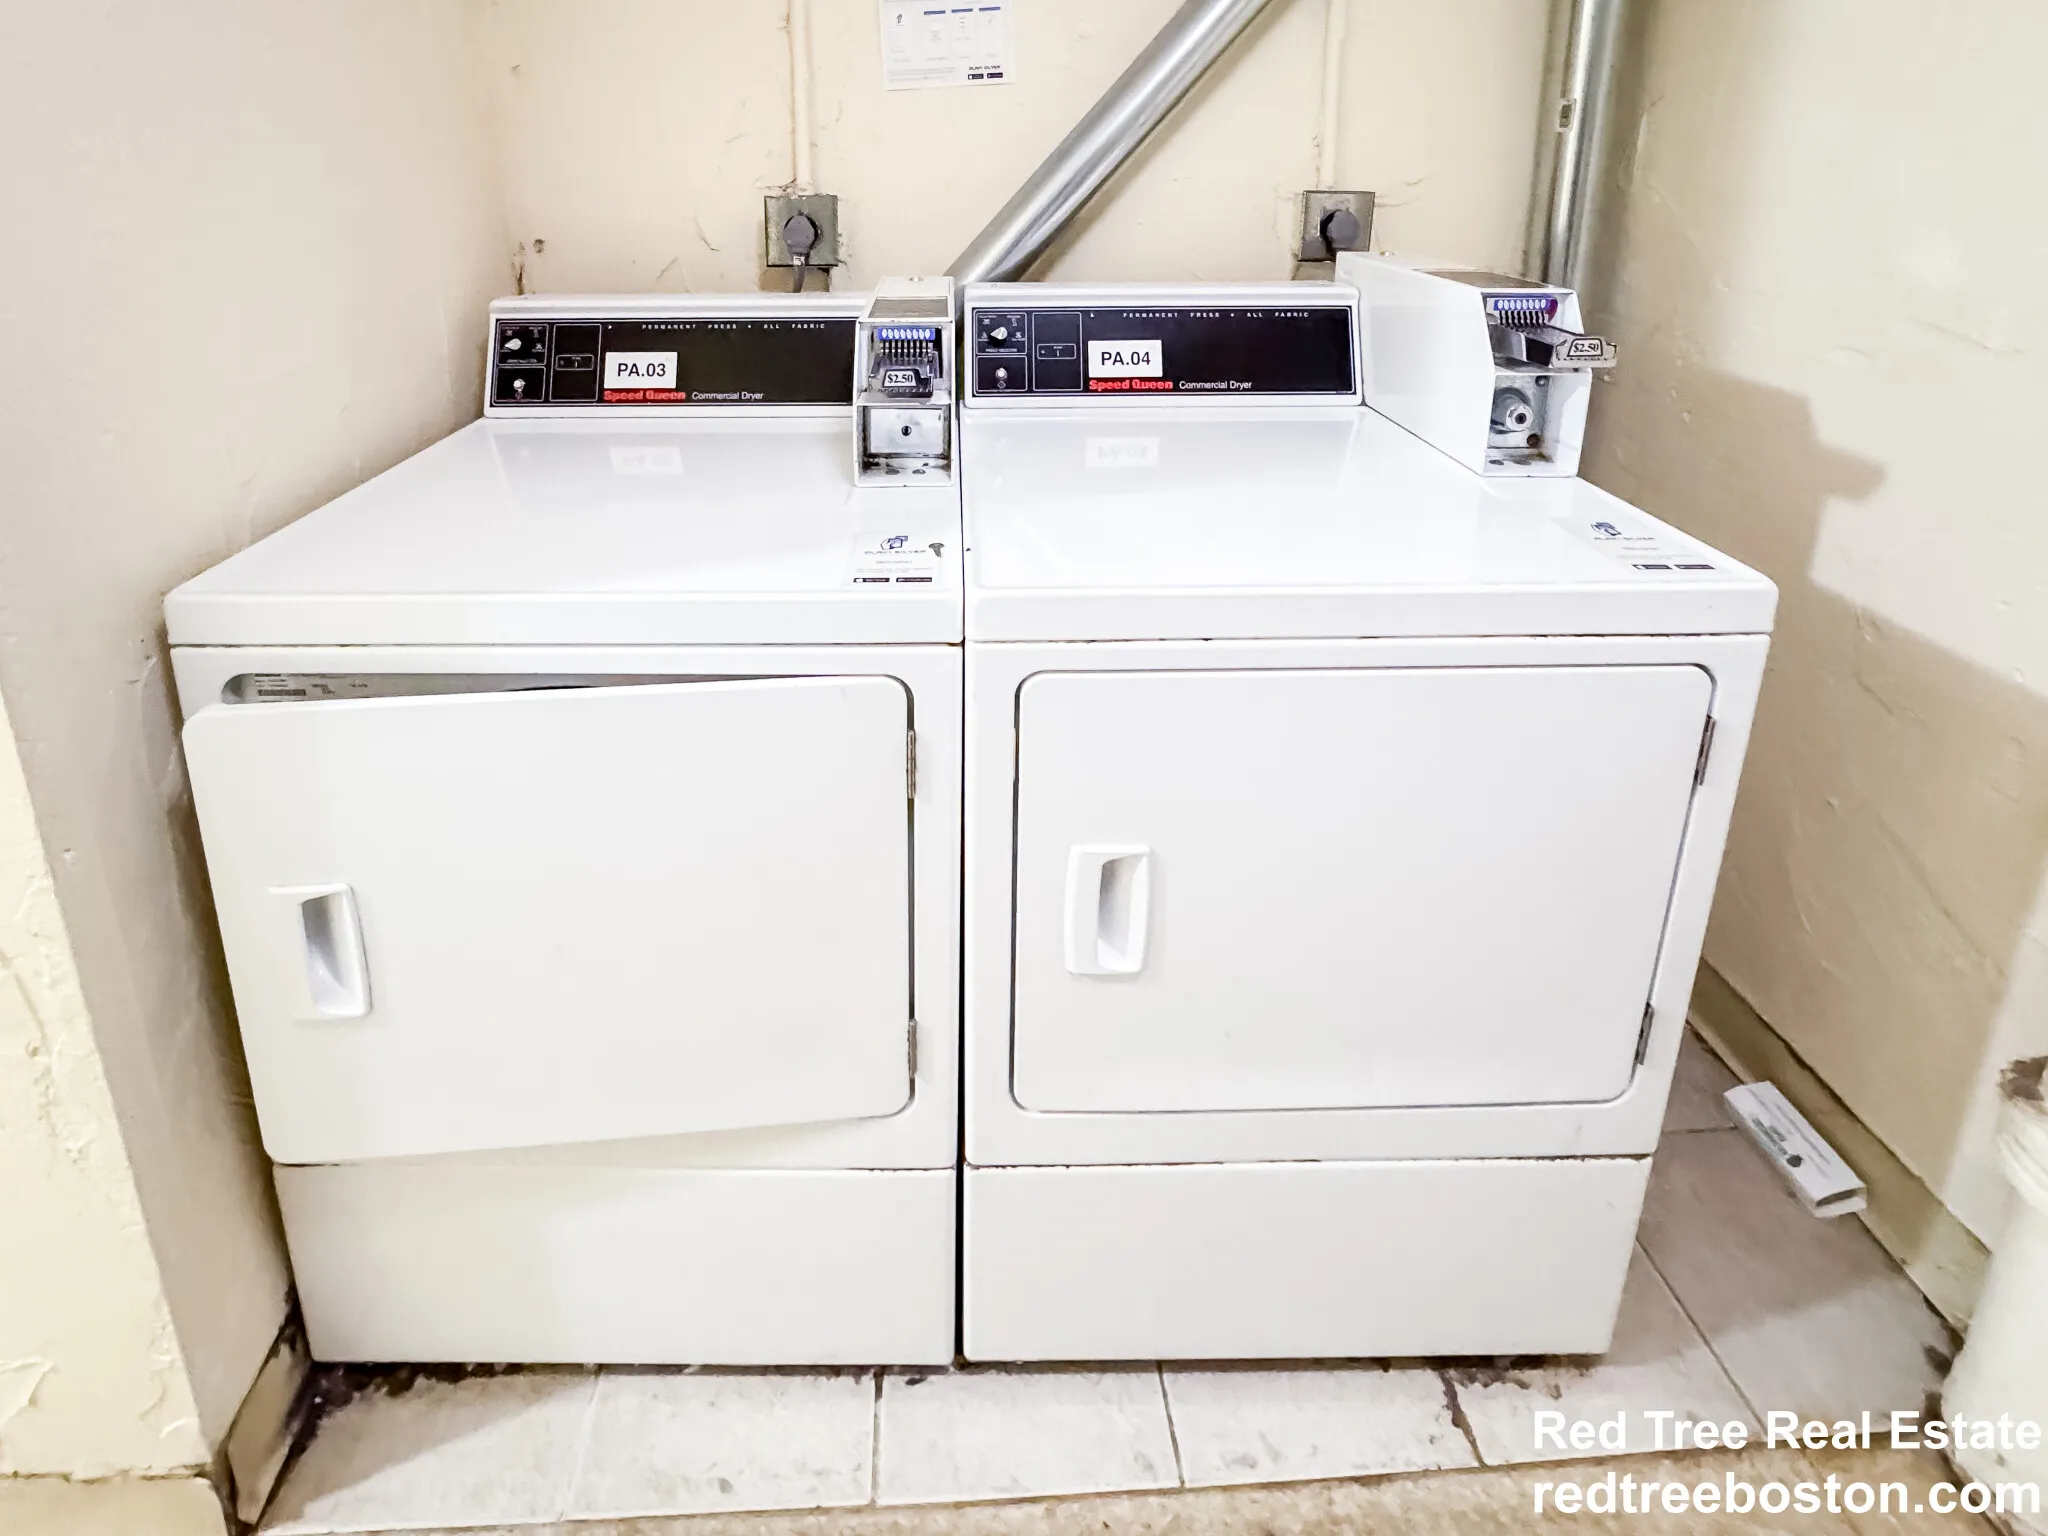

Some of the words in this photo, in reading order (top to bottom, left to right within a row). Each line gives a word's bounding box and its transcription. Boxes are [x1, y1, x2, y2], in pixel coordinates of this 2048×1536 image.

[1573, 342, 1600, 353] $2.50
[1101, 351, 1151, 366] PA.04
[617, 362, 666, 378] PA.03
[887, 373, 913, 384] $2.50
[1088, 379, 1131, 392] Speed
[1132, 379, 1174, 390] Queen
[1179, 380, 1228, 390] Commercial
[1229, 380, 1253, 391] Dryer
[603, 390, 644, 402] Speed
[646, 390, 686, 401] Queen
[692, 391, 740, 400] Commercial
[741, 391, 764, 402] Dryer
